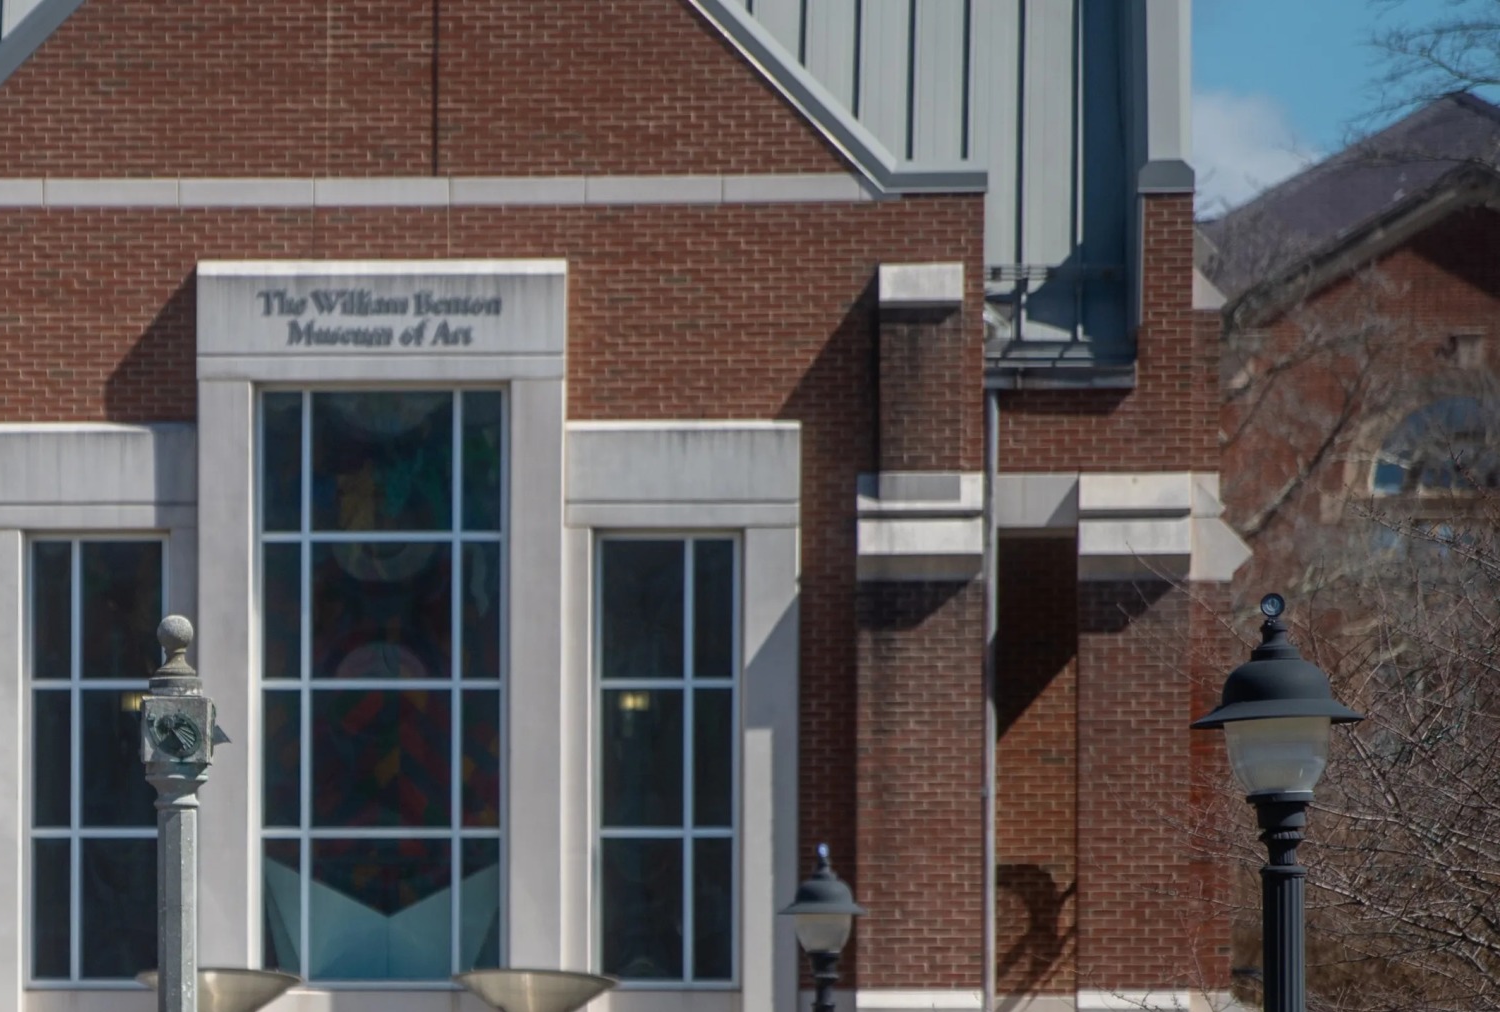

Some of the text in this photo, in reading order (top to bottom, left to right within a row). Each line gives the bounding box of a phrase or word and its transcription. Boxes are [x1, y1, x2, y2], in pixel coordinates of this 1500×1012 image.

[257, 288, 502, 316] The William Benton
[287, 318, 473, 346] Museum of Art
